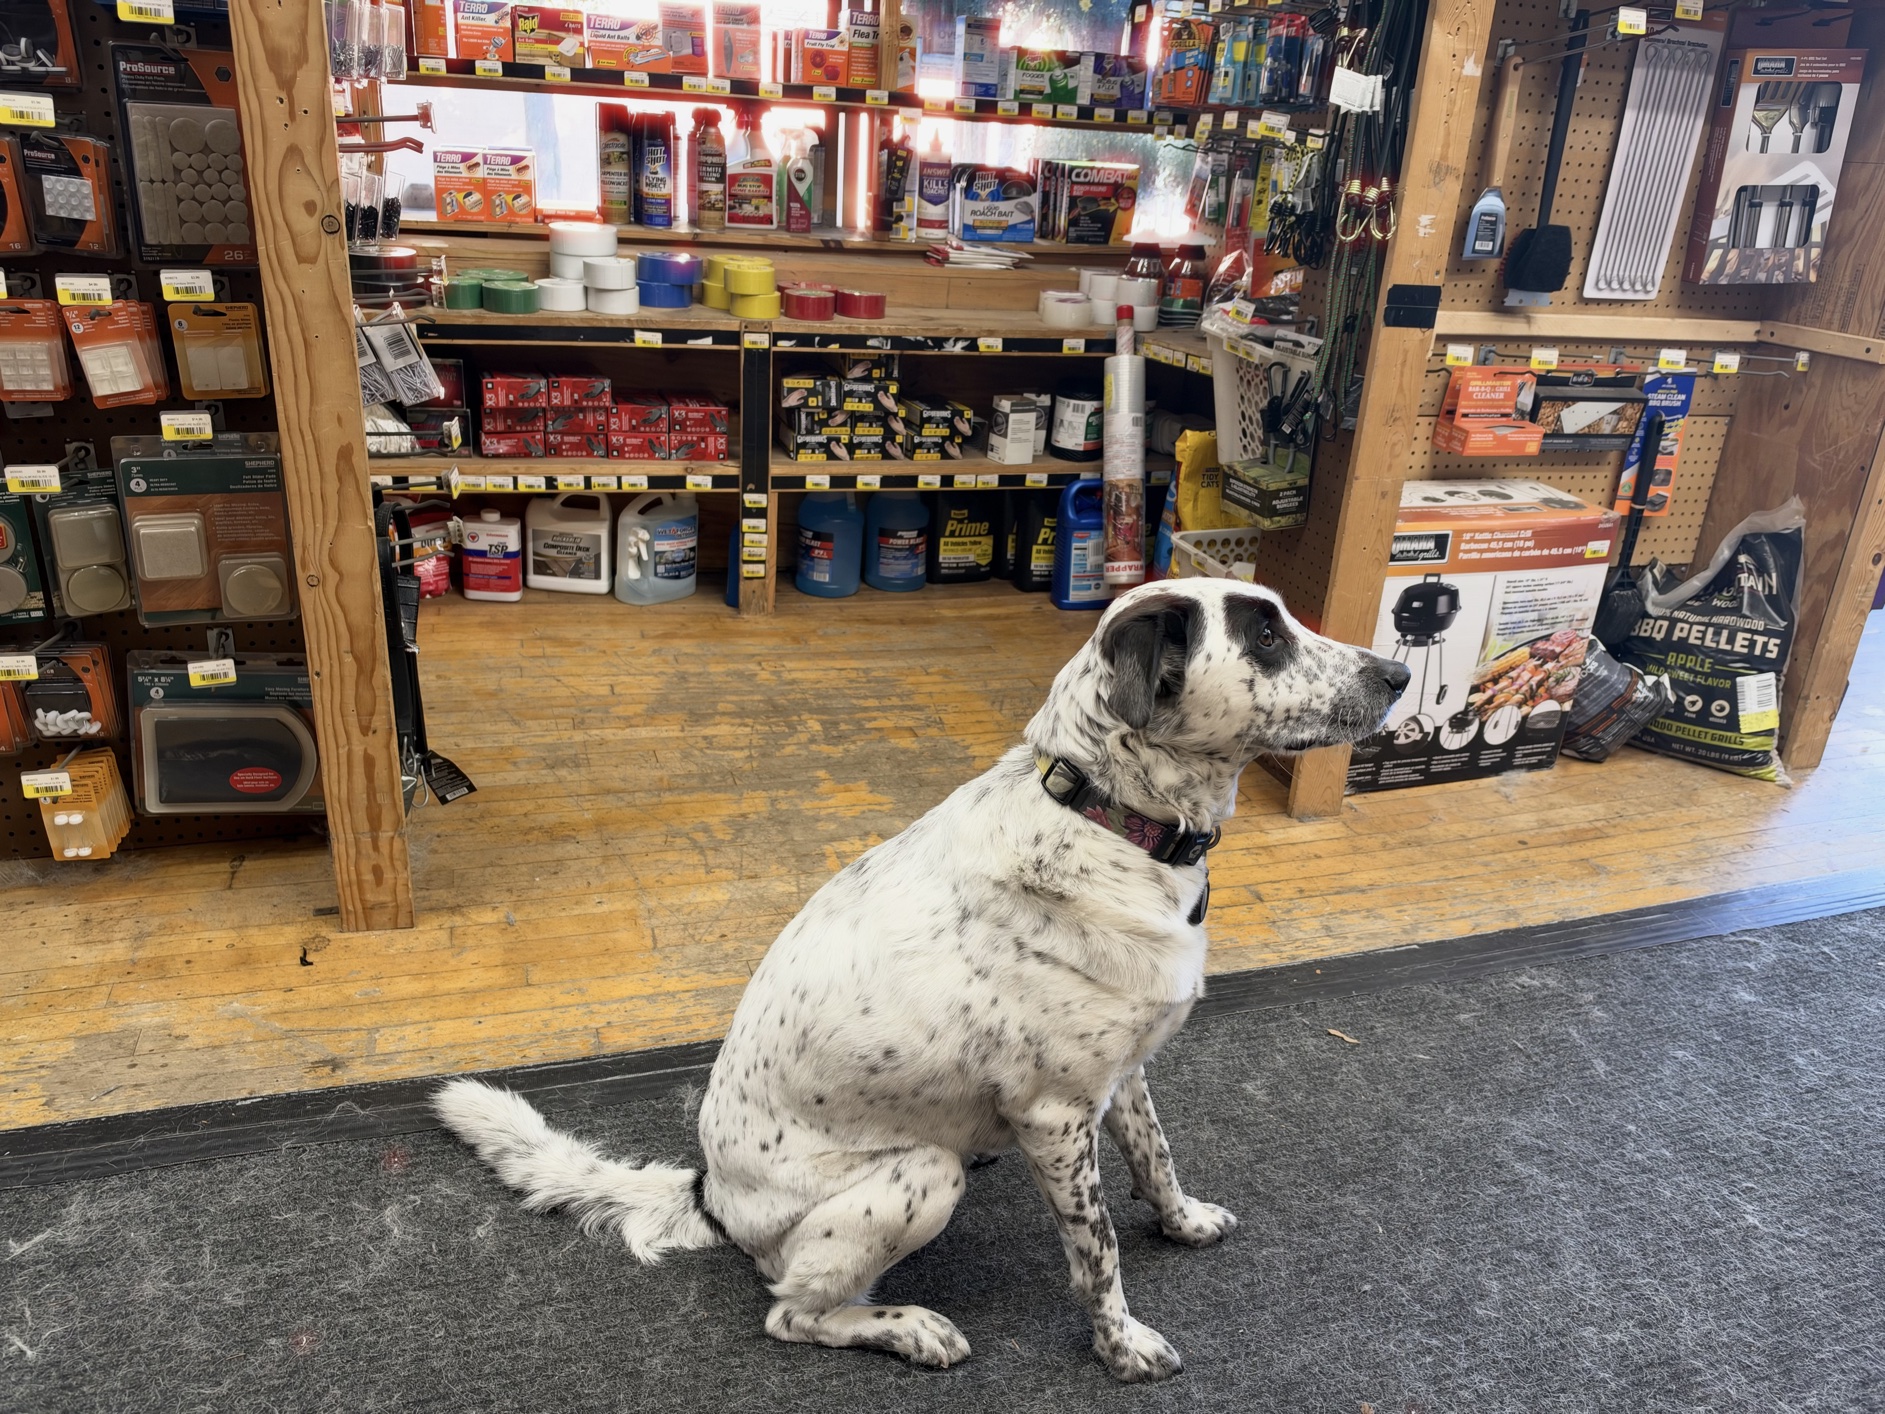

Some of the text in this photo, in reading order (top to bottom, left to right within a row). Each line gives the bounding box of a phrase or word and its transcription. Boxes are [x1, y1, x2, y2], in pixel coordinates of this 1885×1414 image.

[459, 1, 488, 13] TERRO
[519, 16, 538, 32] Raid
[589, 15, 621, 29] TERRO
[852, 12, 880, 26] TERRO
[590, 31, 606, 40] Liquid
[808, 31, 828, 40] TERRO
[852, 29, 870, 39] Flea
[119, 61, 175, 74] ProSource
[23, 149, 55, 159] ProSource
[647, 147, 664, 156] HOT
[436, 152, 462, 163] TERRO
[486, 155, 511, 165] TERRO
[646, 155, 667, 165] SHOT
[976, 171, 995, 181] HOT
[1071, 168, 1127, 184] COMBAT
[923, 180, 949, 189] KILLS
[973, 180, 999, 192] SHOT
[970, 209, 996, 217] ROACH
[224, 250, 244, 260] 26
[486, 394, 496, 406] X3
[551, 392, 560, 404] X3
[673, 410, 686, 418] X3
[610, 418, 619, 430] X3
[485, 438, 498, 447] X3
[549, 434, 561, 442] X3
[611, 436, 624, 444] X3
[717, 437, 726, 449] X3
[1272, 496, 1303, 505] ADJUSTABLE
[945, 520, 989, 536] Prime
[1475, 531, 1492, 539] Kettle
[488, 544, 508, 555] TSP
[1391, 536, 1435, 554] OMAHA
[1489, 541, 1502, 549] 45,5
[1514, 540, 1523, 548] (18
[1524, 540, 1534, 548] po)
[1459, 551, 1480, 559] Parrilla
[1672, 610, 1765, 631] NATURAL HARDWOOD
[1631, 618, 1782, 659] BBQ PELLETS
[1666, 652, 1713, 672] APPLE
[1646, 663, 1665, 675] MILD
[1696, 674, 1732, 689] FLAVOR
[1674, 725, 1709, 740] PELLET
[1710, 733, 1744, 746] GRILLS
[1672, 742, 1684, 751] NET
[1685, 746, 1697, 754] WT.
[1707, 751, 1720, 759] LBS
